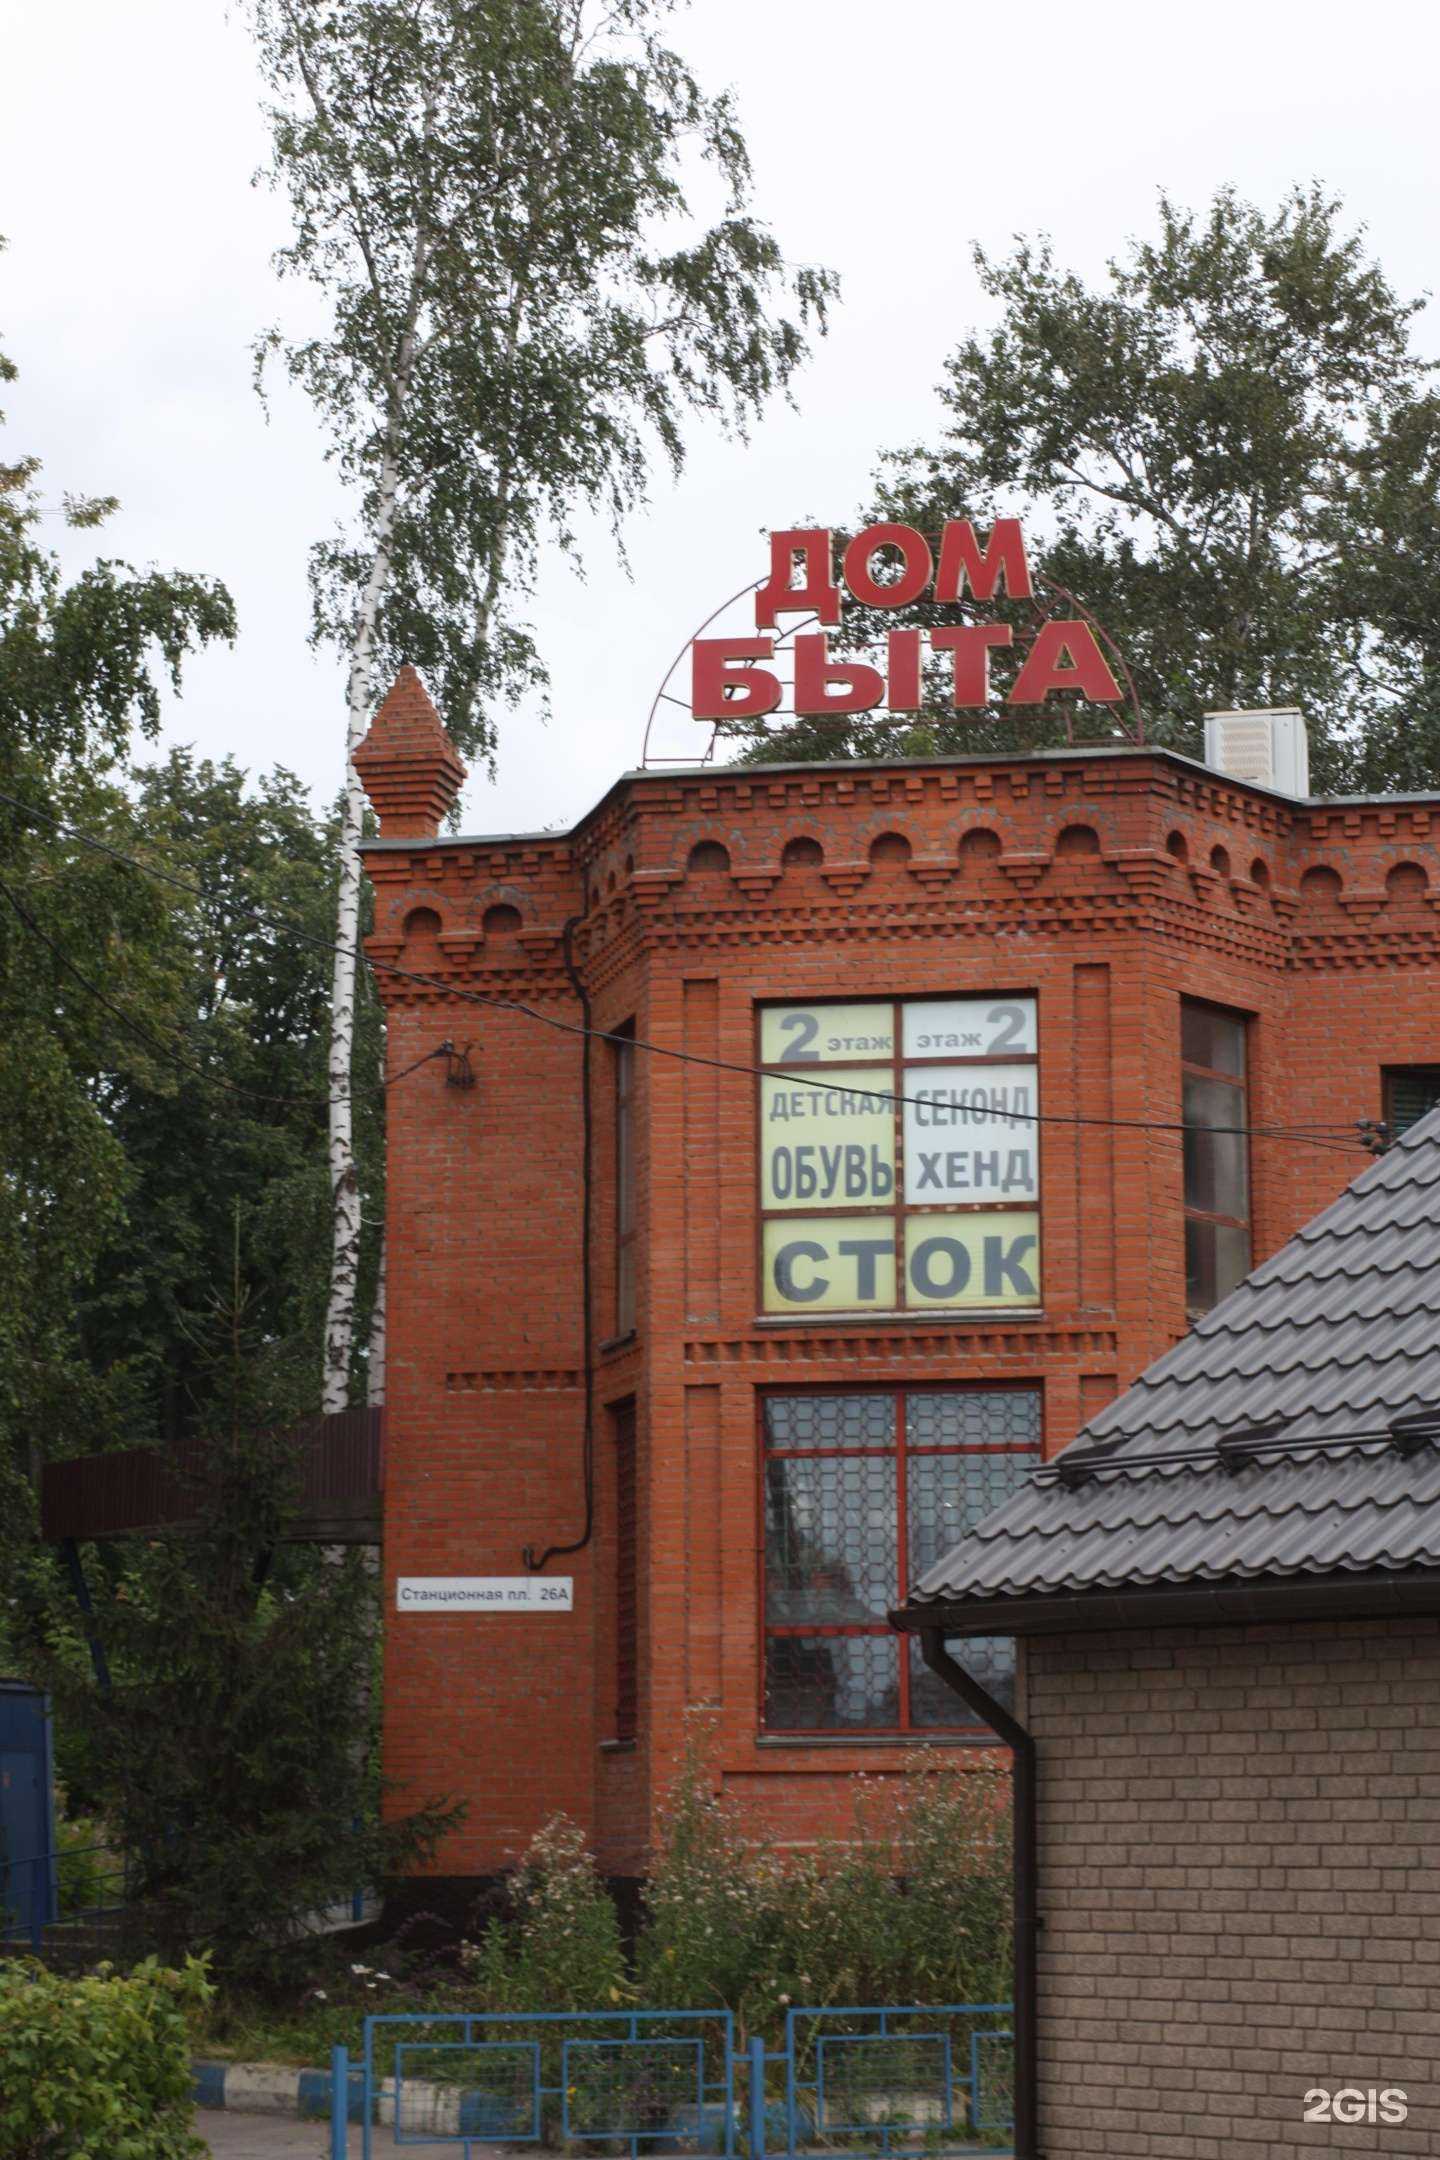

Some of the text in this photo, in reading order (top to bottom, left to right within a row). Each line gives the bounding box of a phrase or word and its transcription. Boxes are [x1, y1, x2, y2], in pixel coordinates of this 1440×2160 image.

[755, 518, 1033, 627] ДОМ
[692, 620, 1124, 721] БЫТА
[778, 1012, 894, 1063] 2 этаж
[917, 1005, 1028, 1056] этаж 2
[771, 1143, 894, 1200] ОБУВЬ
[915, 1149, 1034, 1194] ХЕНД
[773, 1234, 1038, 1303] СТОК
[401, 1588, 569, 1602] Станционная пл. 26А
